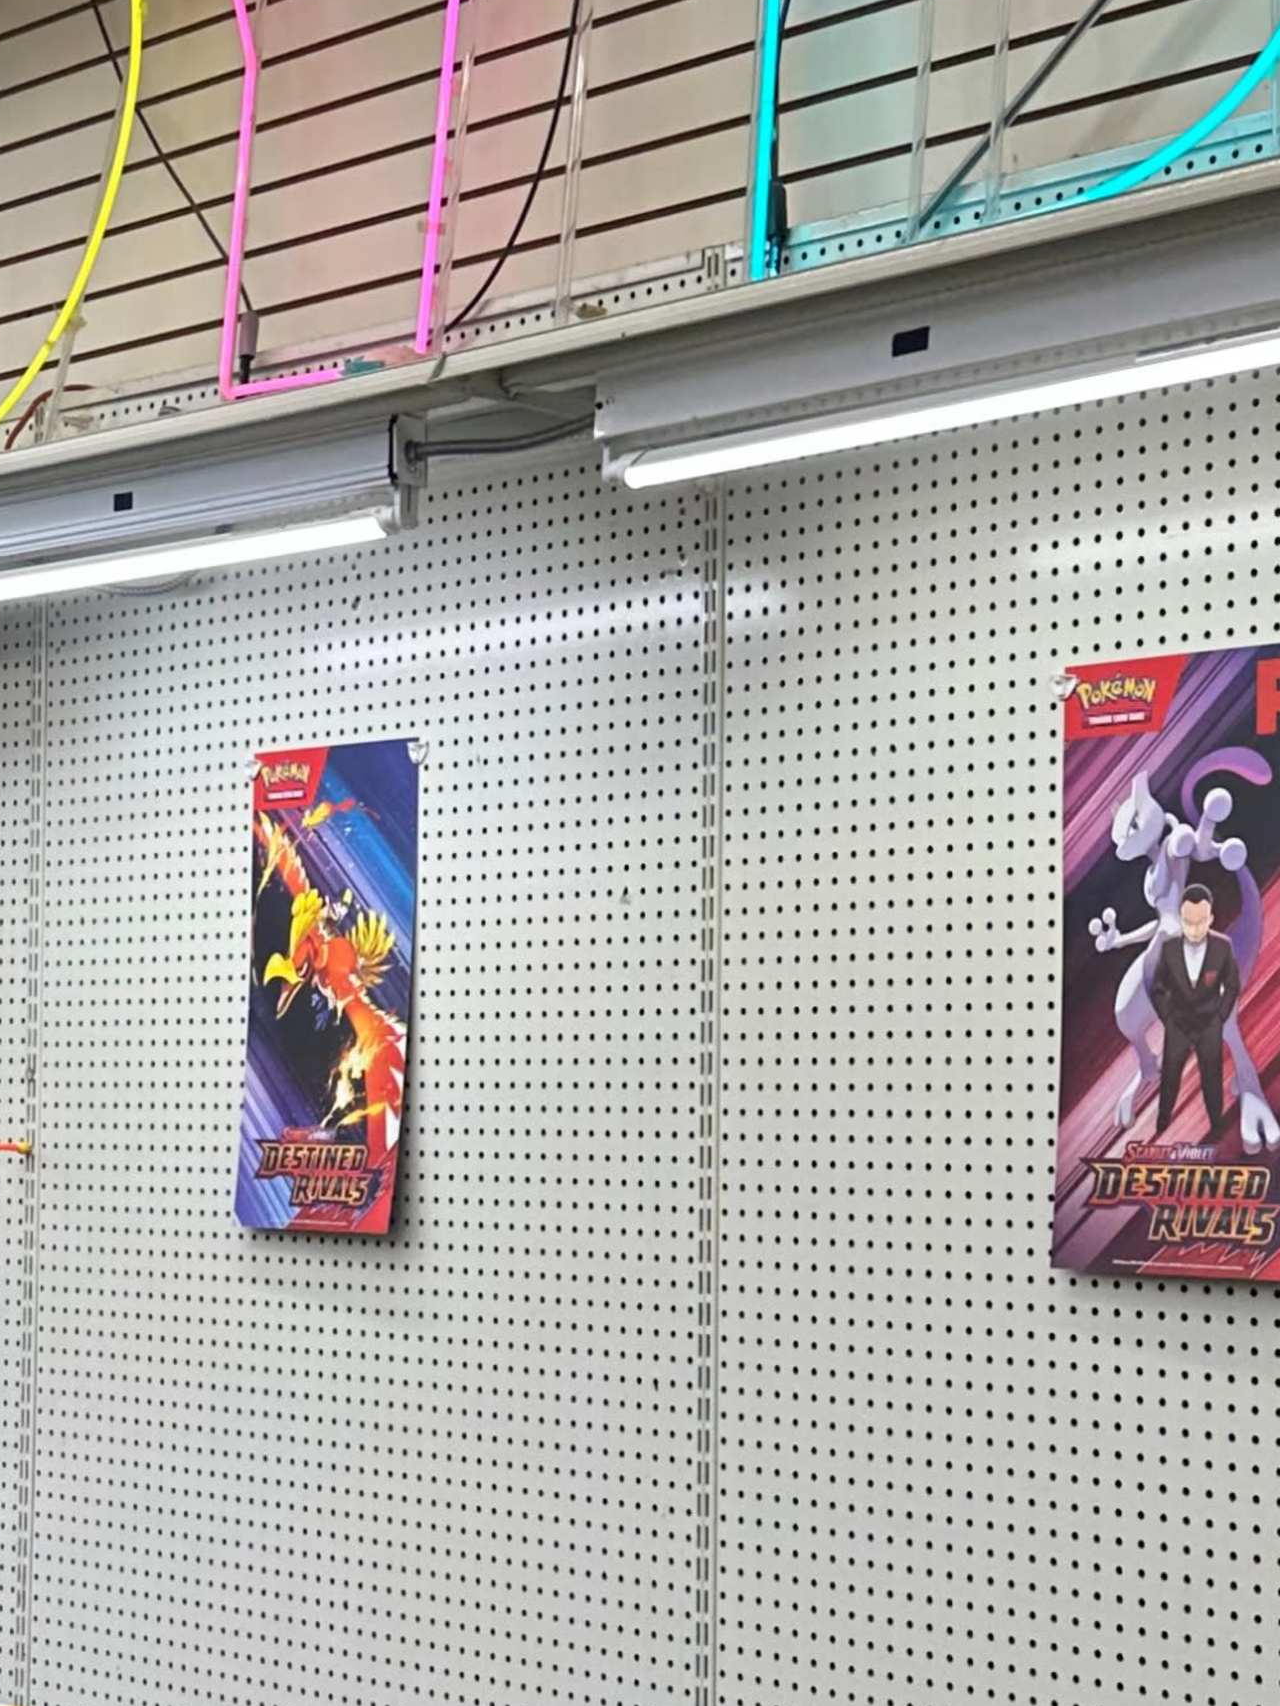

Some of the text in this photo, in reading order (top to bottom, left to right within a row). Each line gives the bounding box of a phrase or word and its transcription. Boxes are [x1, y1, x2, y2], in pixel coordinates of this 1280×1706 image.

[257, 1143, 369, 1177] DESTINED
[291, 1173, 371, 1206] RIVALS
[1089, 1162, 1272, 1205] DESTINED
